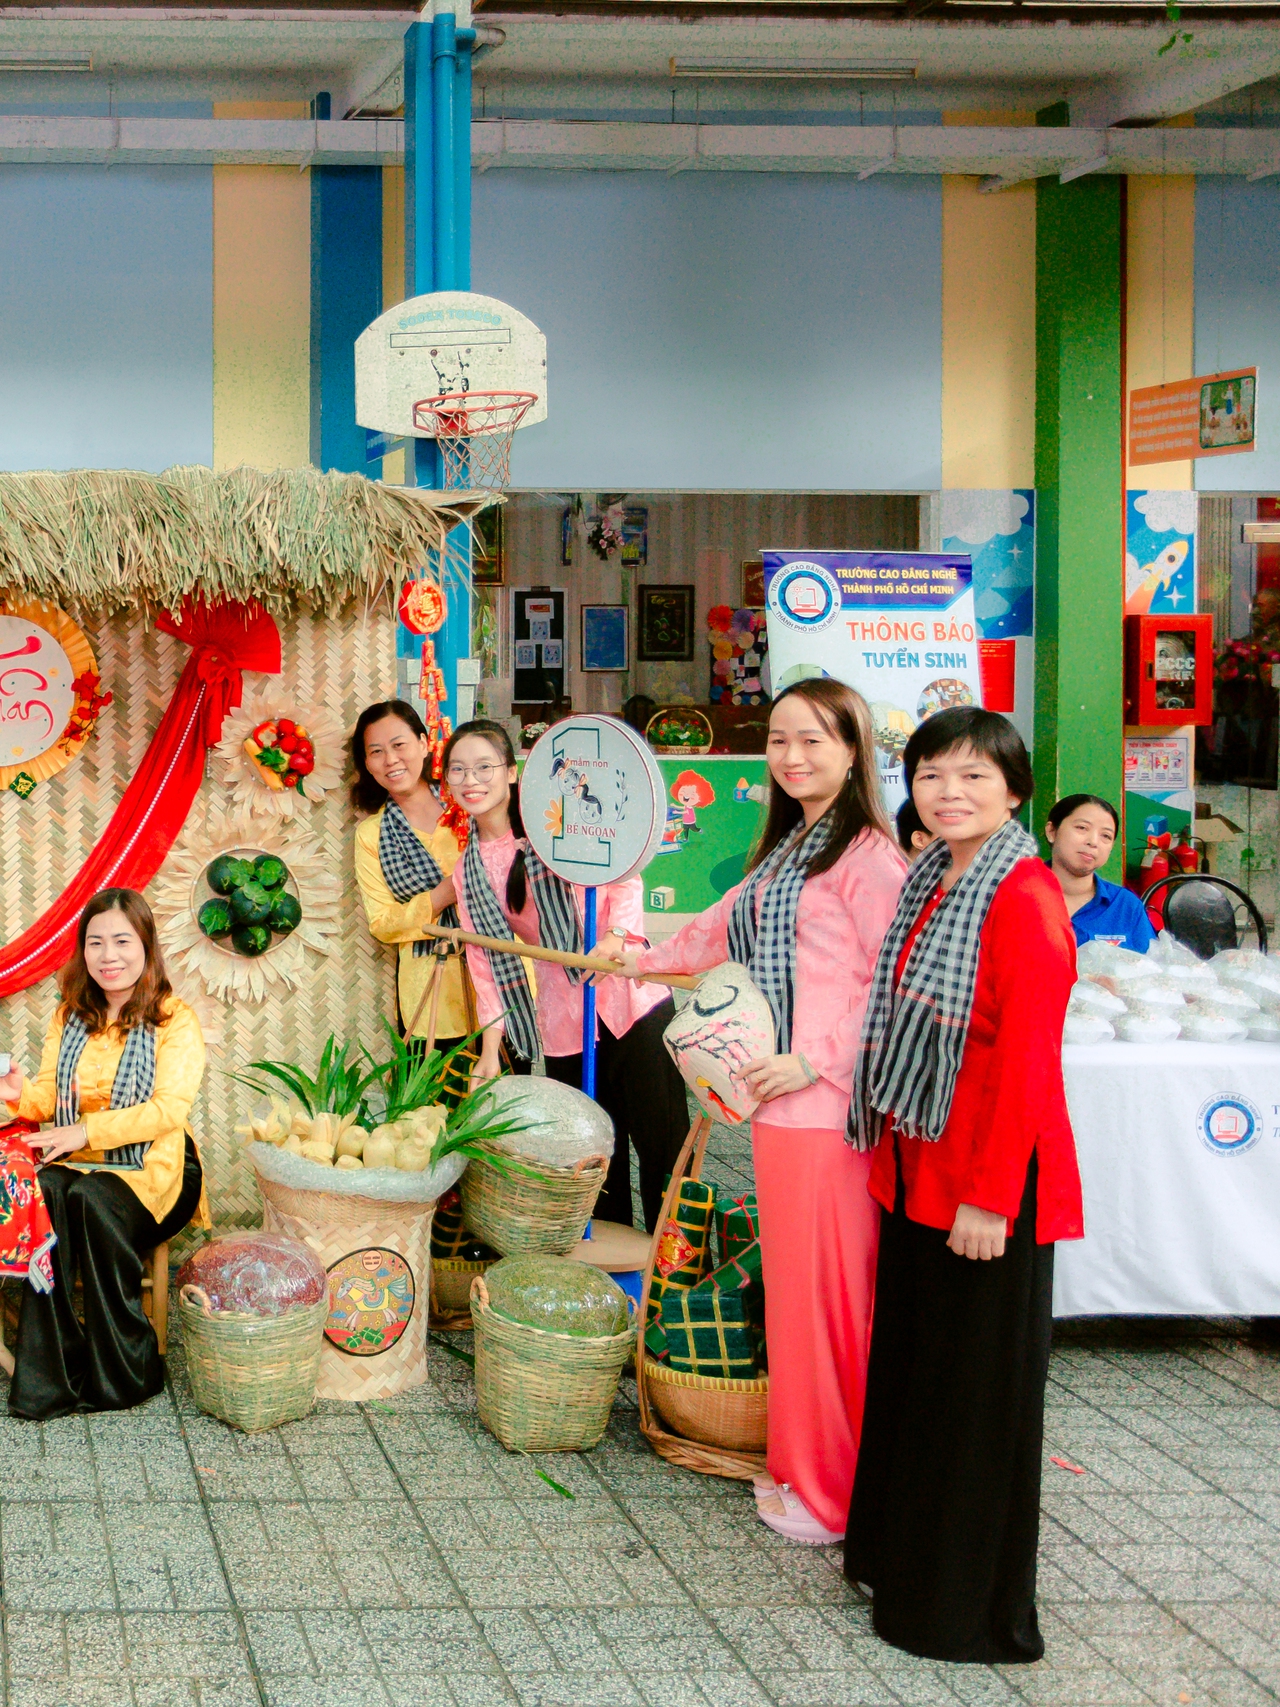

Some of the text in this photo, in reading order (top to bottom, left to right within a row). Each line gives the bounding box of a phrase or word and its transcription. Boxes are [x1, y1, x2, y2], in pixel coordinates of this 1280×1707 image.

[398, 309, 444, 330] SODEX
[791, 564, 804, 572] CAO
[835, 567, 958, 580] TRƯỜNG CAO ĐẲNG NGHỀ
[842, 584, 954, 595] THÀNH PHỐ HỒ CHÍ MINH
[845, 615, 974, 643] THÔNG BÁO
[862, 647, 967, 668] TUYỂN SINH
[1156, 657, 1195, 670] PCCC
[593, 760, 609, 768] non
[878, 774, 899, 785] NTT
[566, 822, 616, 838] BÉ NGOAN
[1147, 823, 1155, 833] A
[653, 894, 662, 906] B
